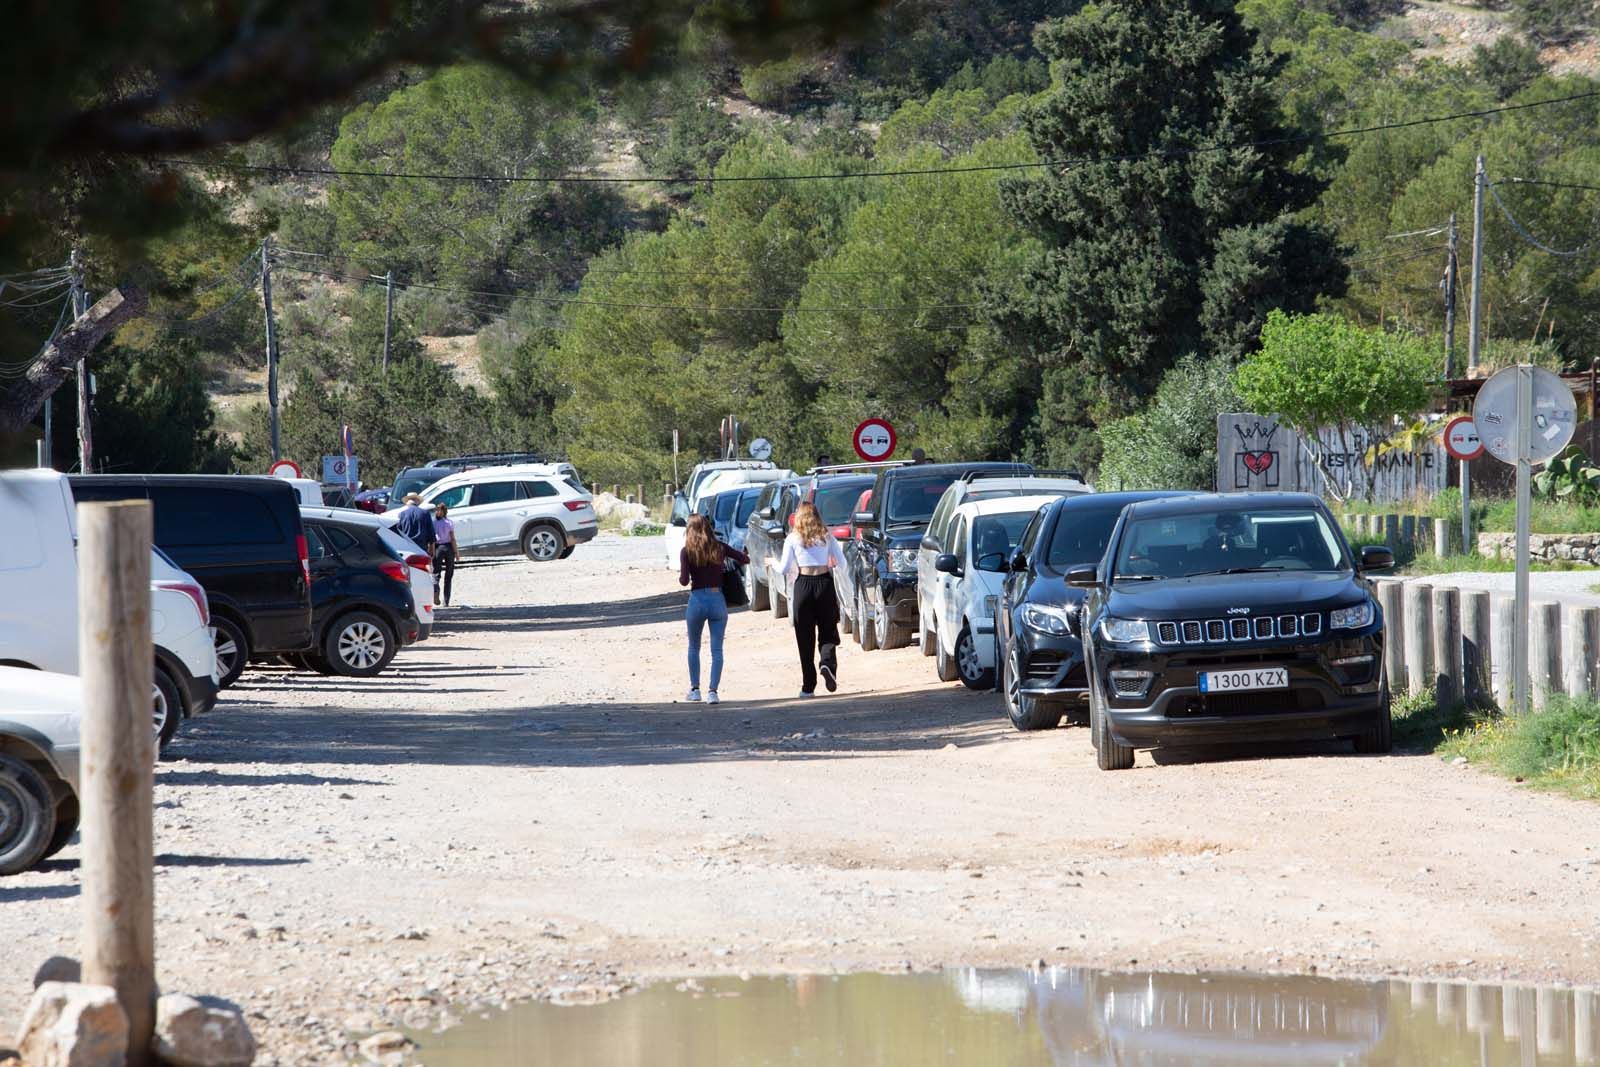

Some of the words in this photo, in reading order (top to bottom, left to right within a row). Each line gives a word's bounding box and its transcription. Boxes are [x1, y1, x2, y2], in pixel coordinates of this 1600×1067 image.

[1316, 452, 1433, 472] RESTARANTE
[1226, 607, 1251, 615] Jeep
[1213, 673, 1251, 689] 1300
[1255, 670, 1285, 687] KZX
